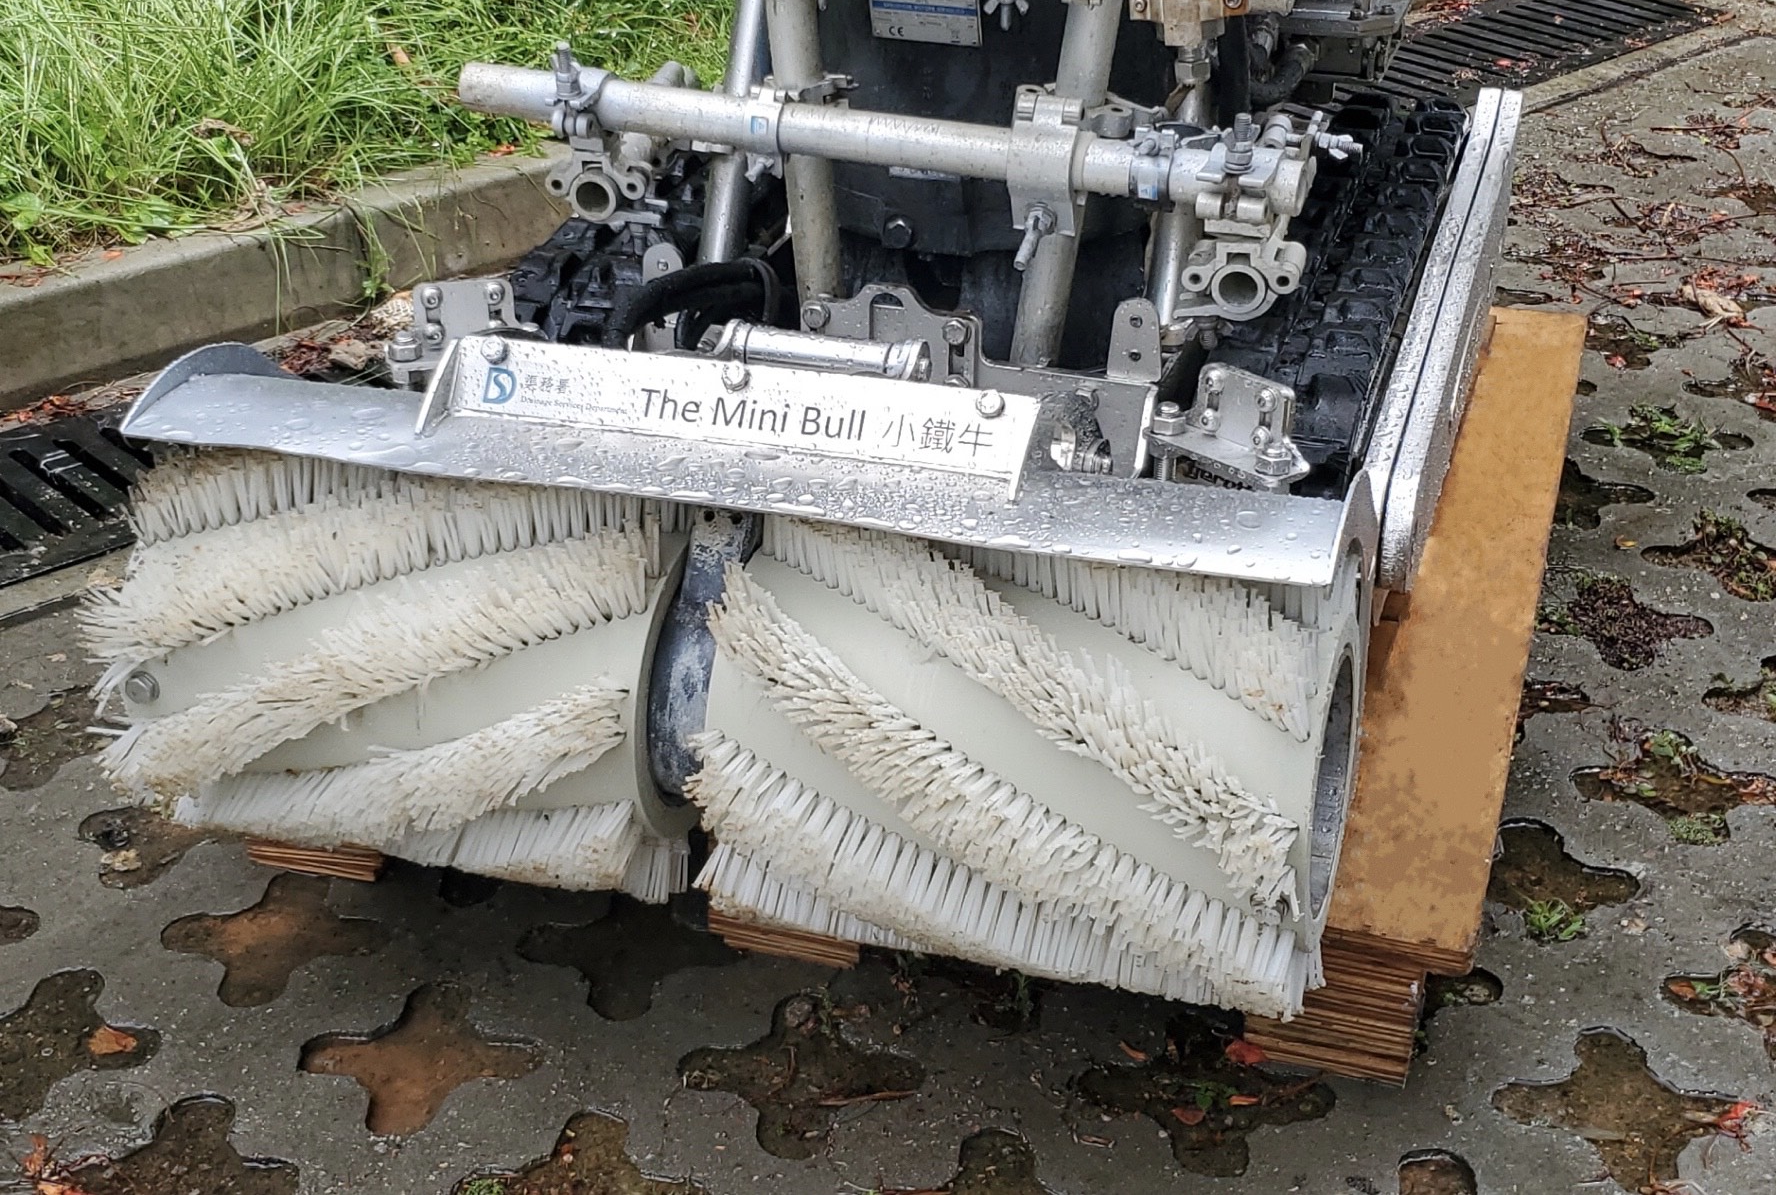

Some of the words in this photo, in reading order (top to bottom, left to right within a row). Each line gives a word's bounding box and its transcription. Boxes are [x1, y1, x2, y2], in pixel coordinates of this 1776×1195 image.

[641, 388, 701, 423] The
[711, 397, 790, 432] Mini
[801, 406, 866, 441] Bull
[882, 414, 994, 457] 小鐵牛
